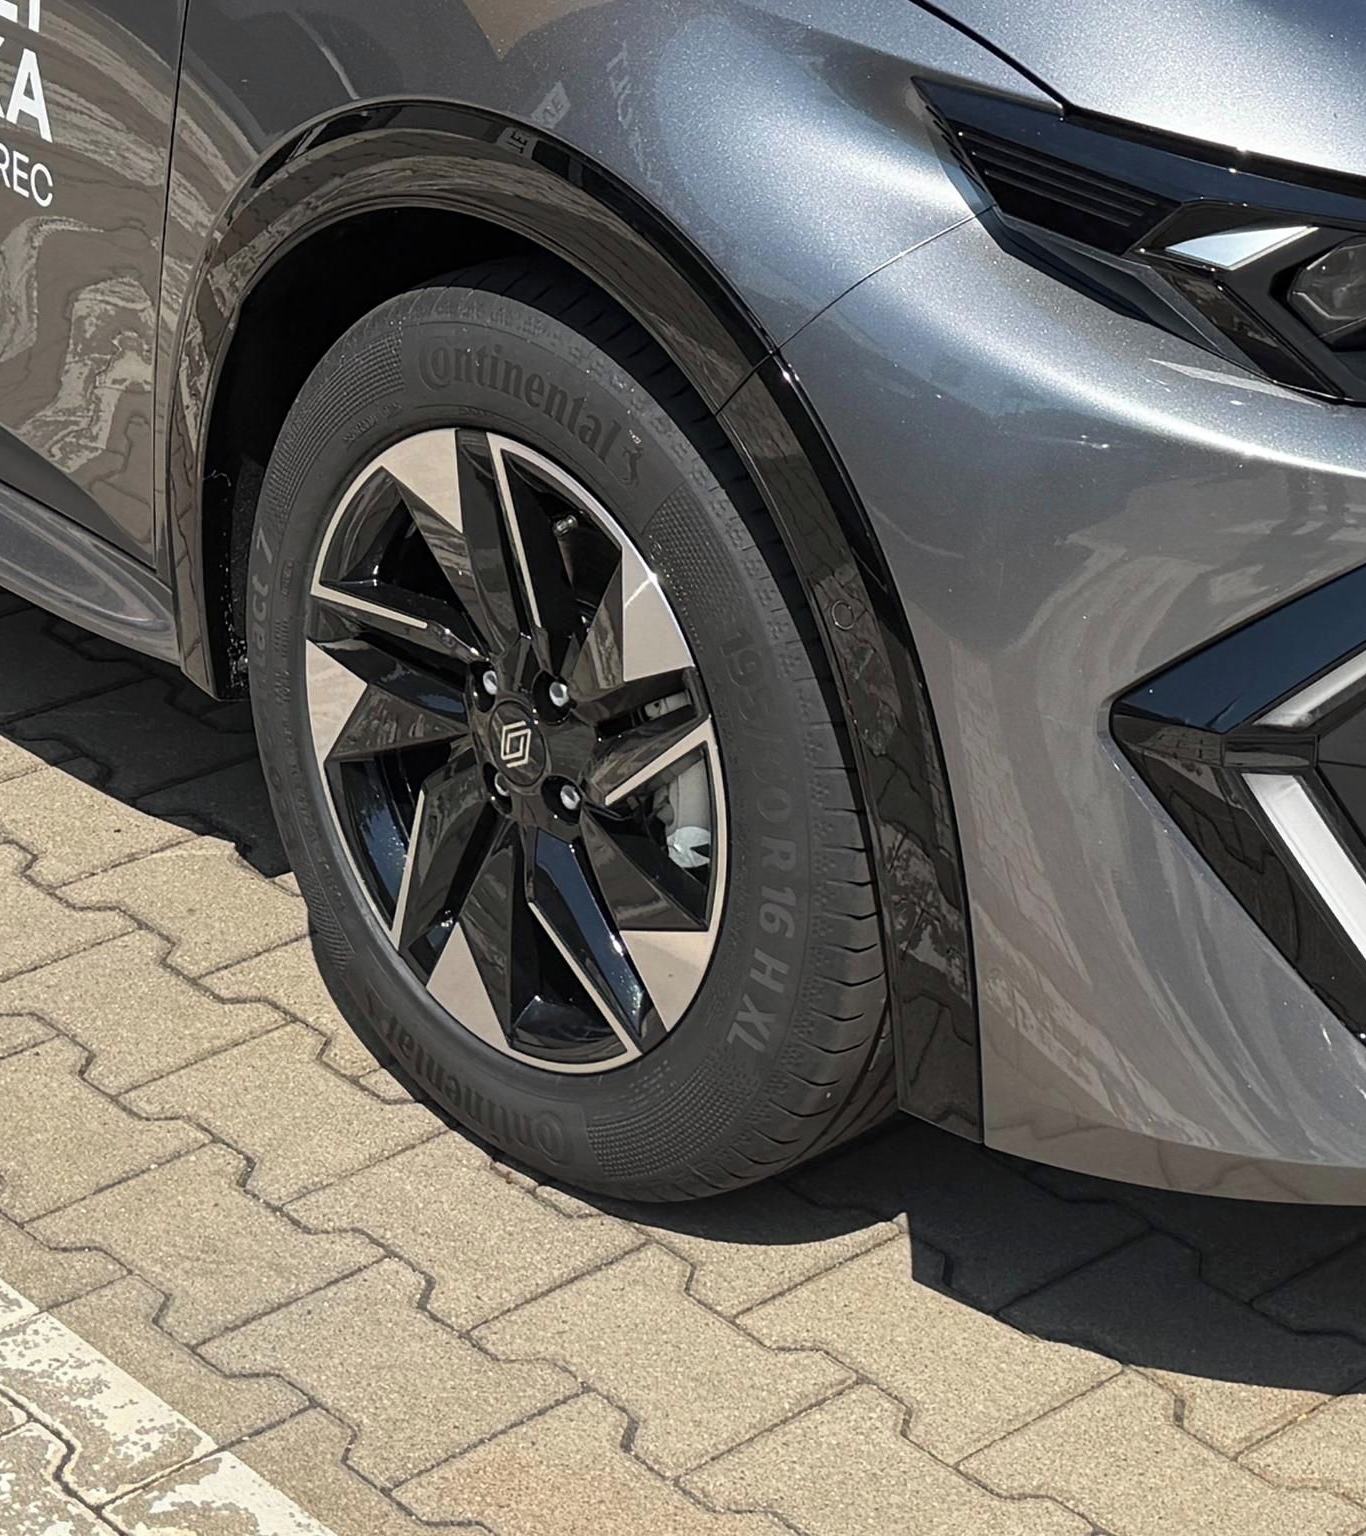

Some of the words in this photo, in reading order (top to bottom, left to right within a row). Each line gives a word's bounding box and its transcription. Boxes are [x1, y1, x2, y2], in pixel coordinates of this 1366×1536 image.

[418, 336, 623, 464] Continental
[749, 947, 790, 994] H
[726, 993, 777, 1053] XL
